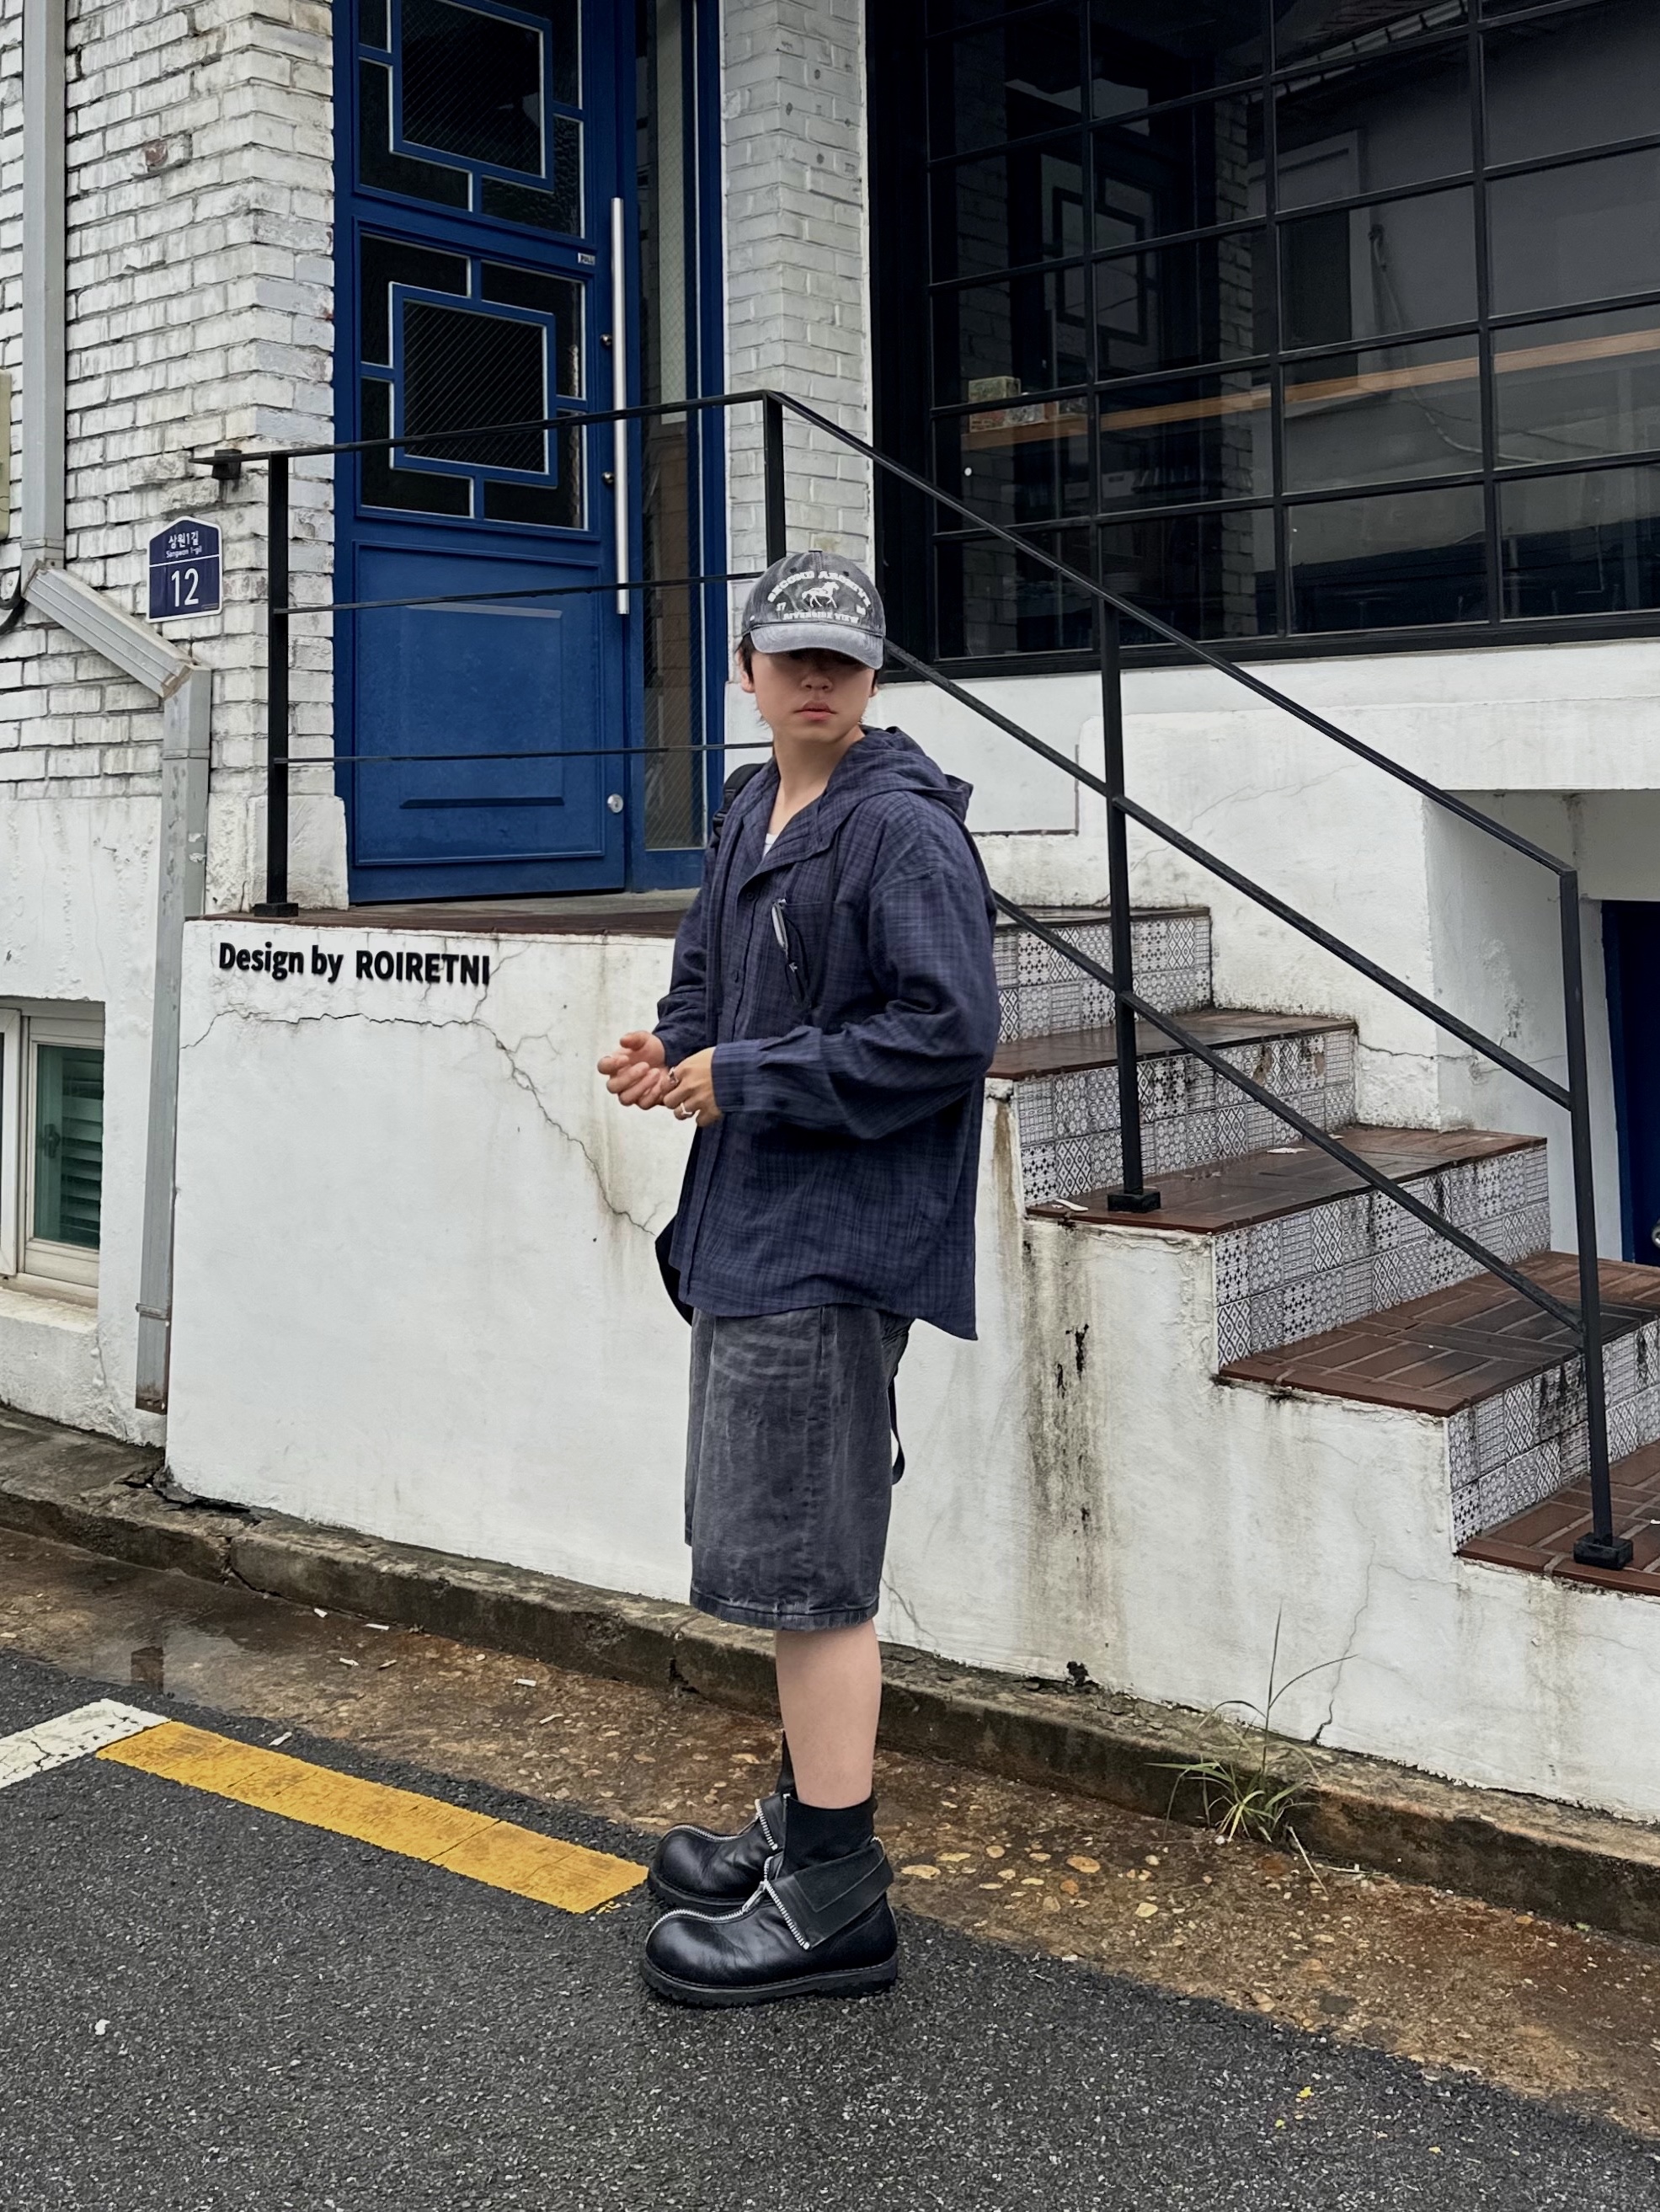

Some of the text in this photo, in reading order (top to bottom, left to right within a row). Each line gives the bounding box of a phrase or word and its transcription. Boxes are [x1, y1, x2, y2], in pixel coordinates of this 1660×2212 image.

[168, 531, 199, 549] 상원1길
[171, 568, 199, 606] 12
[767, 570, 815, 602] SECOND
[835, 613, 859, 623] VIEW
[219, 941, 490, 986] Design by ROIRETNI
